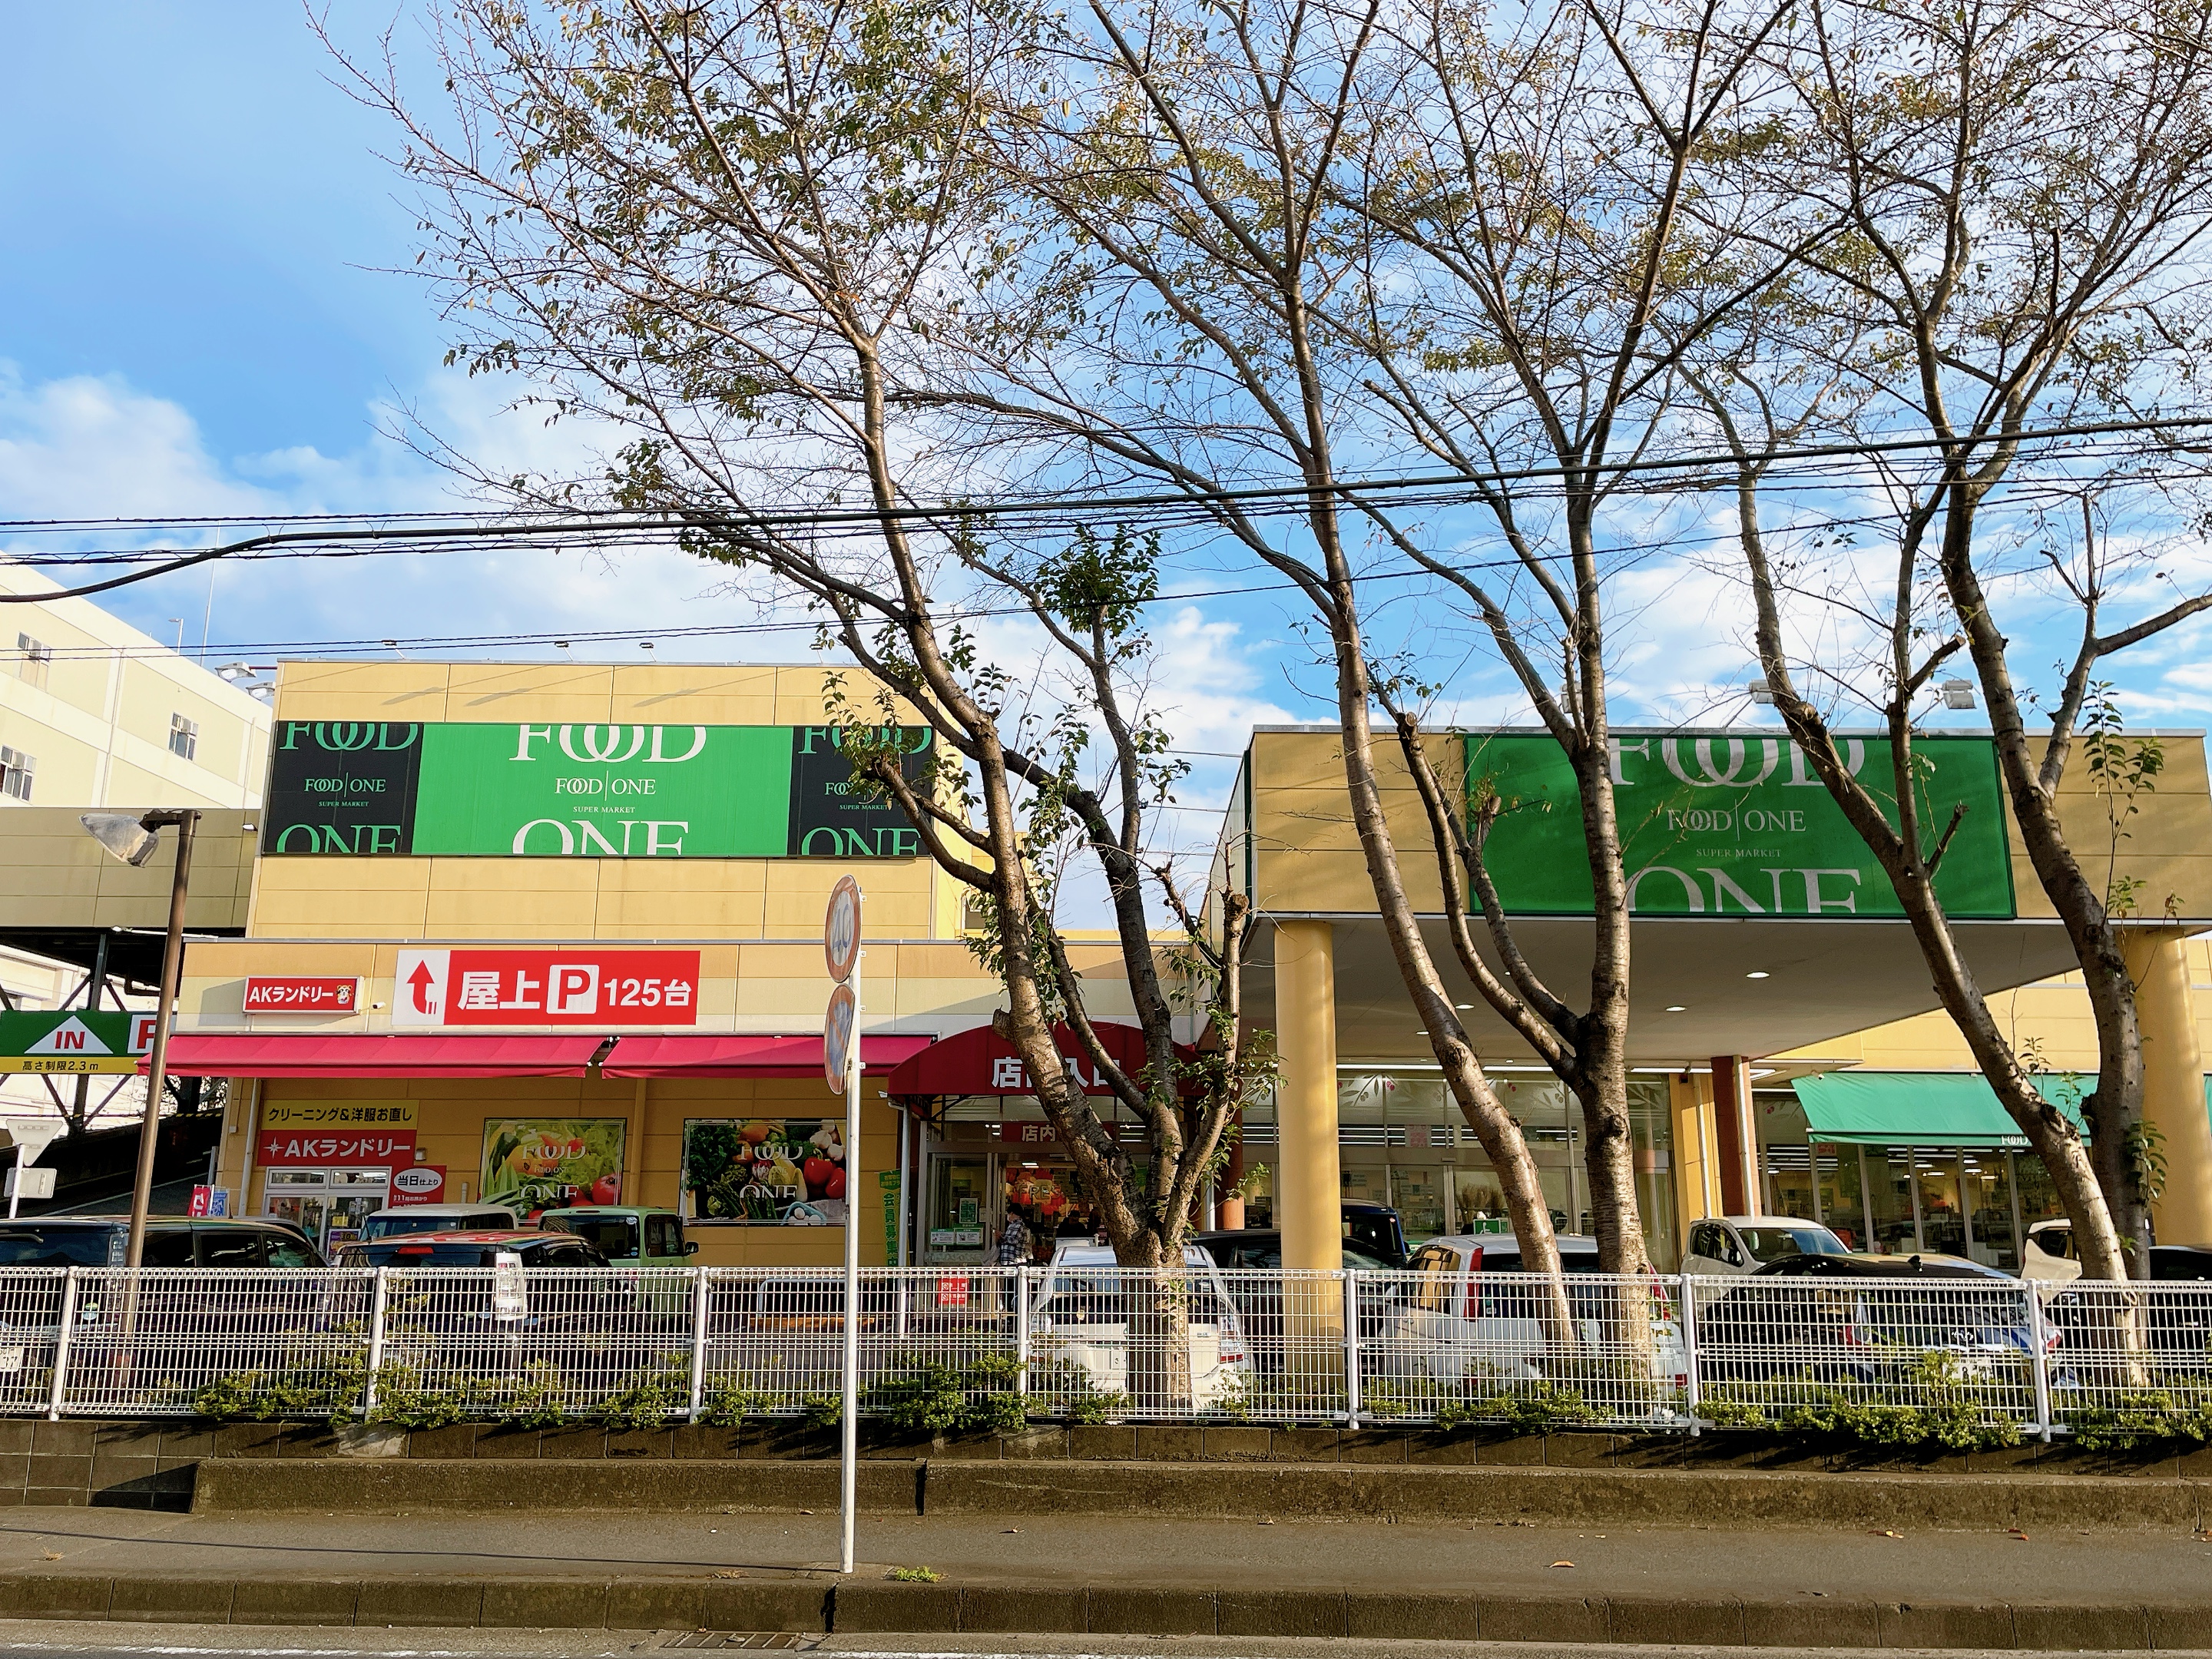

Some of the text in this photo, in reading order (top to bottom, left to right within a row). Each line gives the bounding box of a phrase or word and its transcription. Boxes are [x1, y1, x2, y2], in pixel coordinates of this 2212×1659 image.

[279, 723, 419, 750] FOOD
[508, 724, 706, 763] FOOD
[349, 778, 386, 793] ONE
[611, 778, 656, 795] ONE
[1744, 810, 1806, 833] ONE
[276, 823, 401, 853] ONE
[512, 819, 689, 856] ONE
[1696, 848, 1782, 859] SUPER MARKET
[248, 985, 334, 1004] AKランドリー
[55, 1031, 85, 1050] IN
[284, 1138, 411, 1157] AKランドリー
[397, 1175, 439, 1186] 当日仕上り
